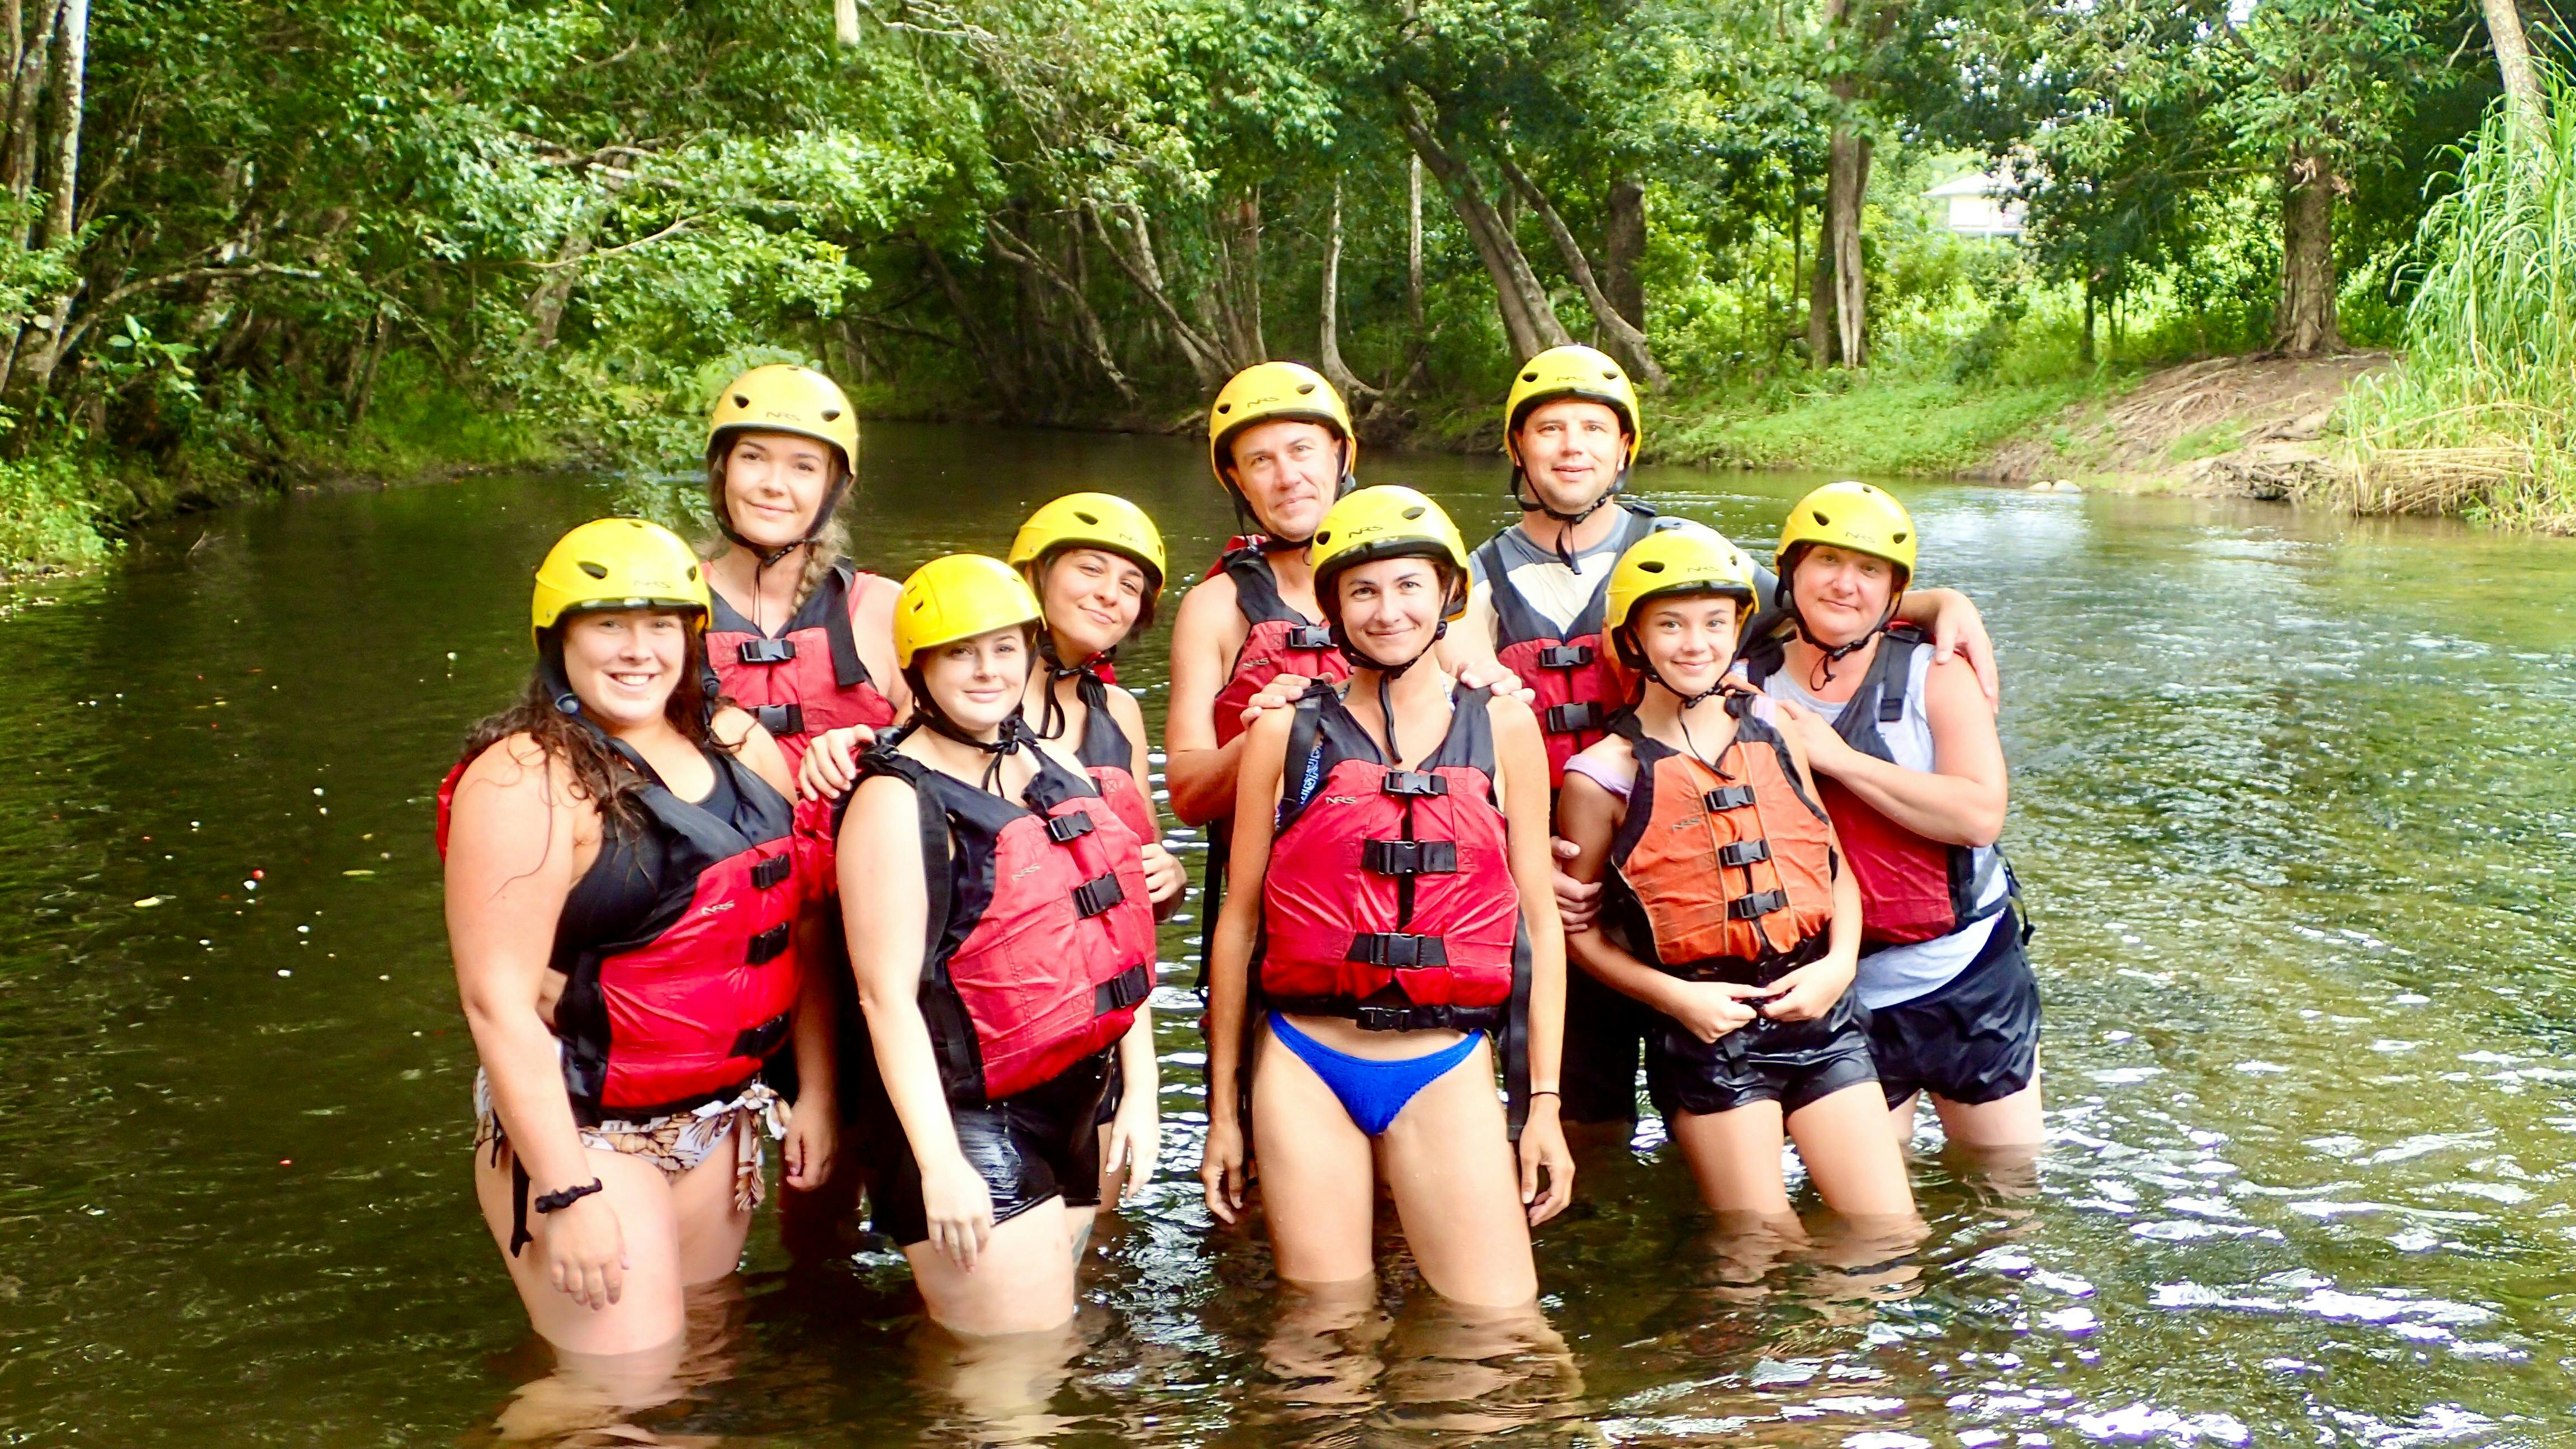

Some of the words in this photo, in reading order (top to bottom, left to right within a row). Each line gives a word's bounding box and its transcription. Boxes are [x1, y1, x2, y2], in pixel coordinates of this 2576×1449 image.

[1348, 526, 1384, 539] NRS
[1325, 795, 1356, 804] NRS
[1010, 864, 1041, 881] NRS
[701, 899, 734, 916] NRS
